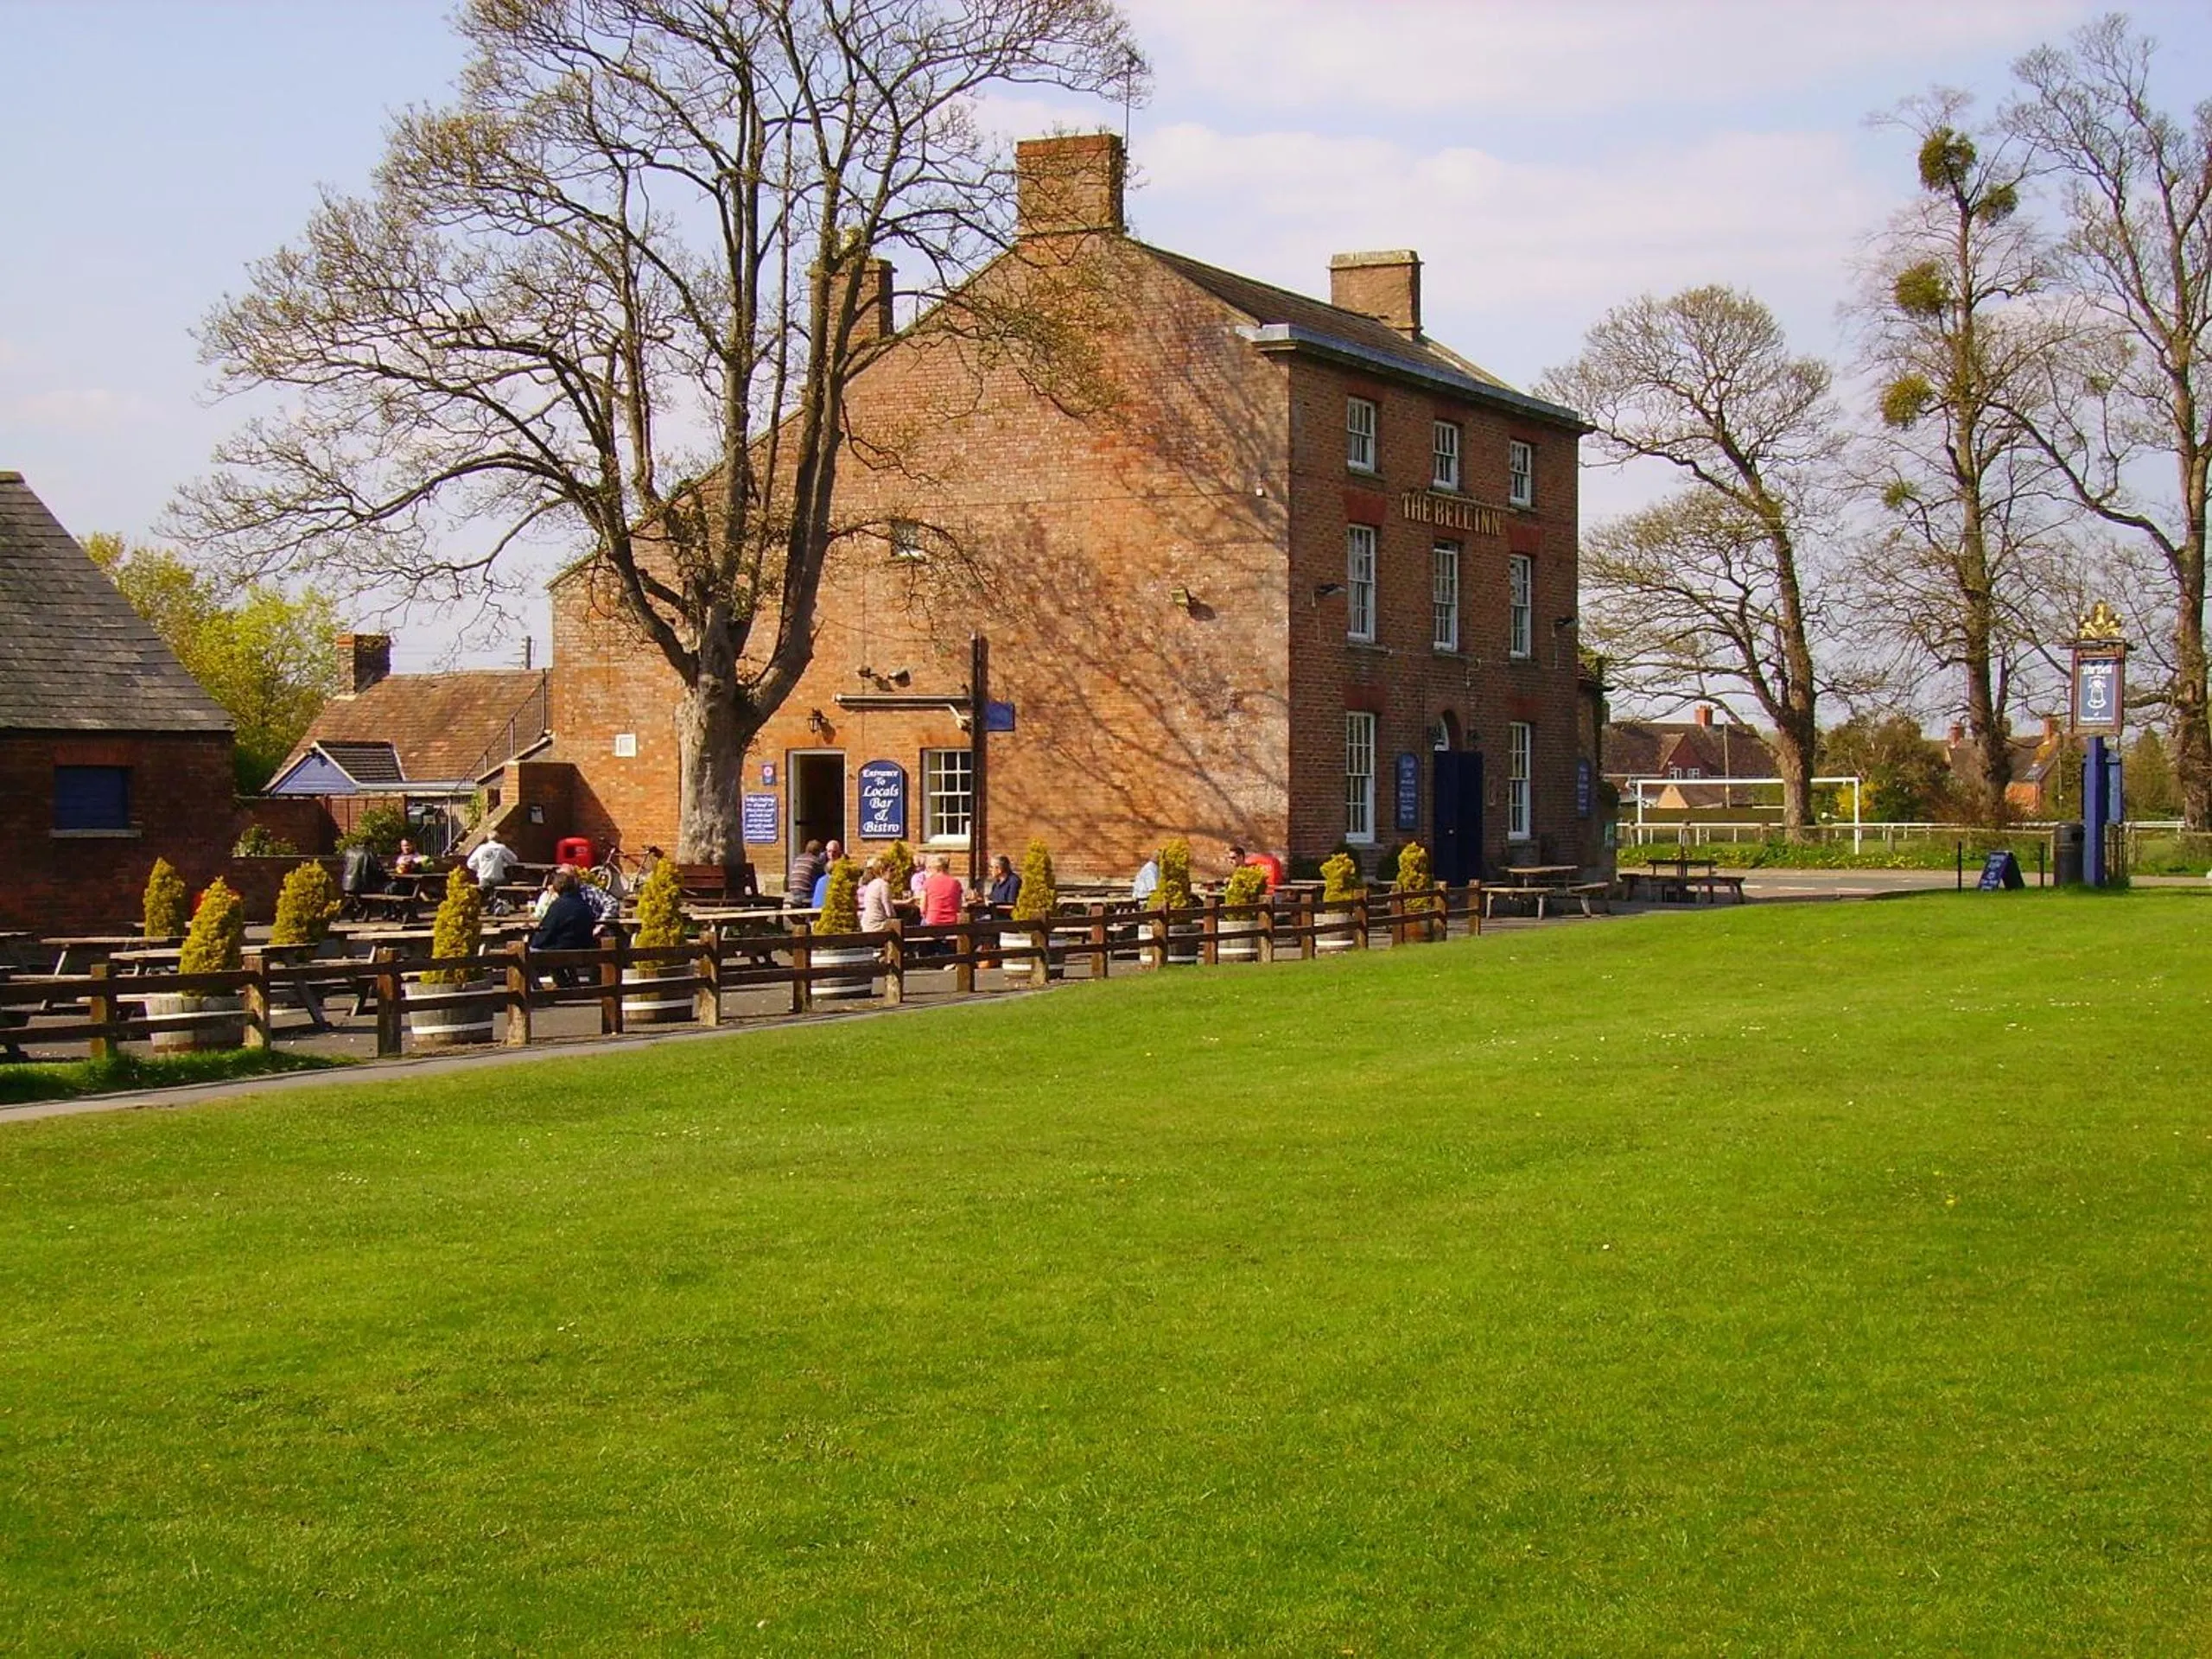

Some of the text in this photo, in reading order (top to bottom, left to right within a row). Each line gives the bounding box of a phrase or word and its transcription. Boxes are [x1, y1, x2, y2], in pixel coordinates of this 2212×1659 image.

[1402, 493, 1501, 536] THE BELL INN
[862, 784, 899, 797] Locals
[869, 797, 893, 809] Bar
[863, 821, 899, 833] Bistro
